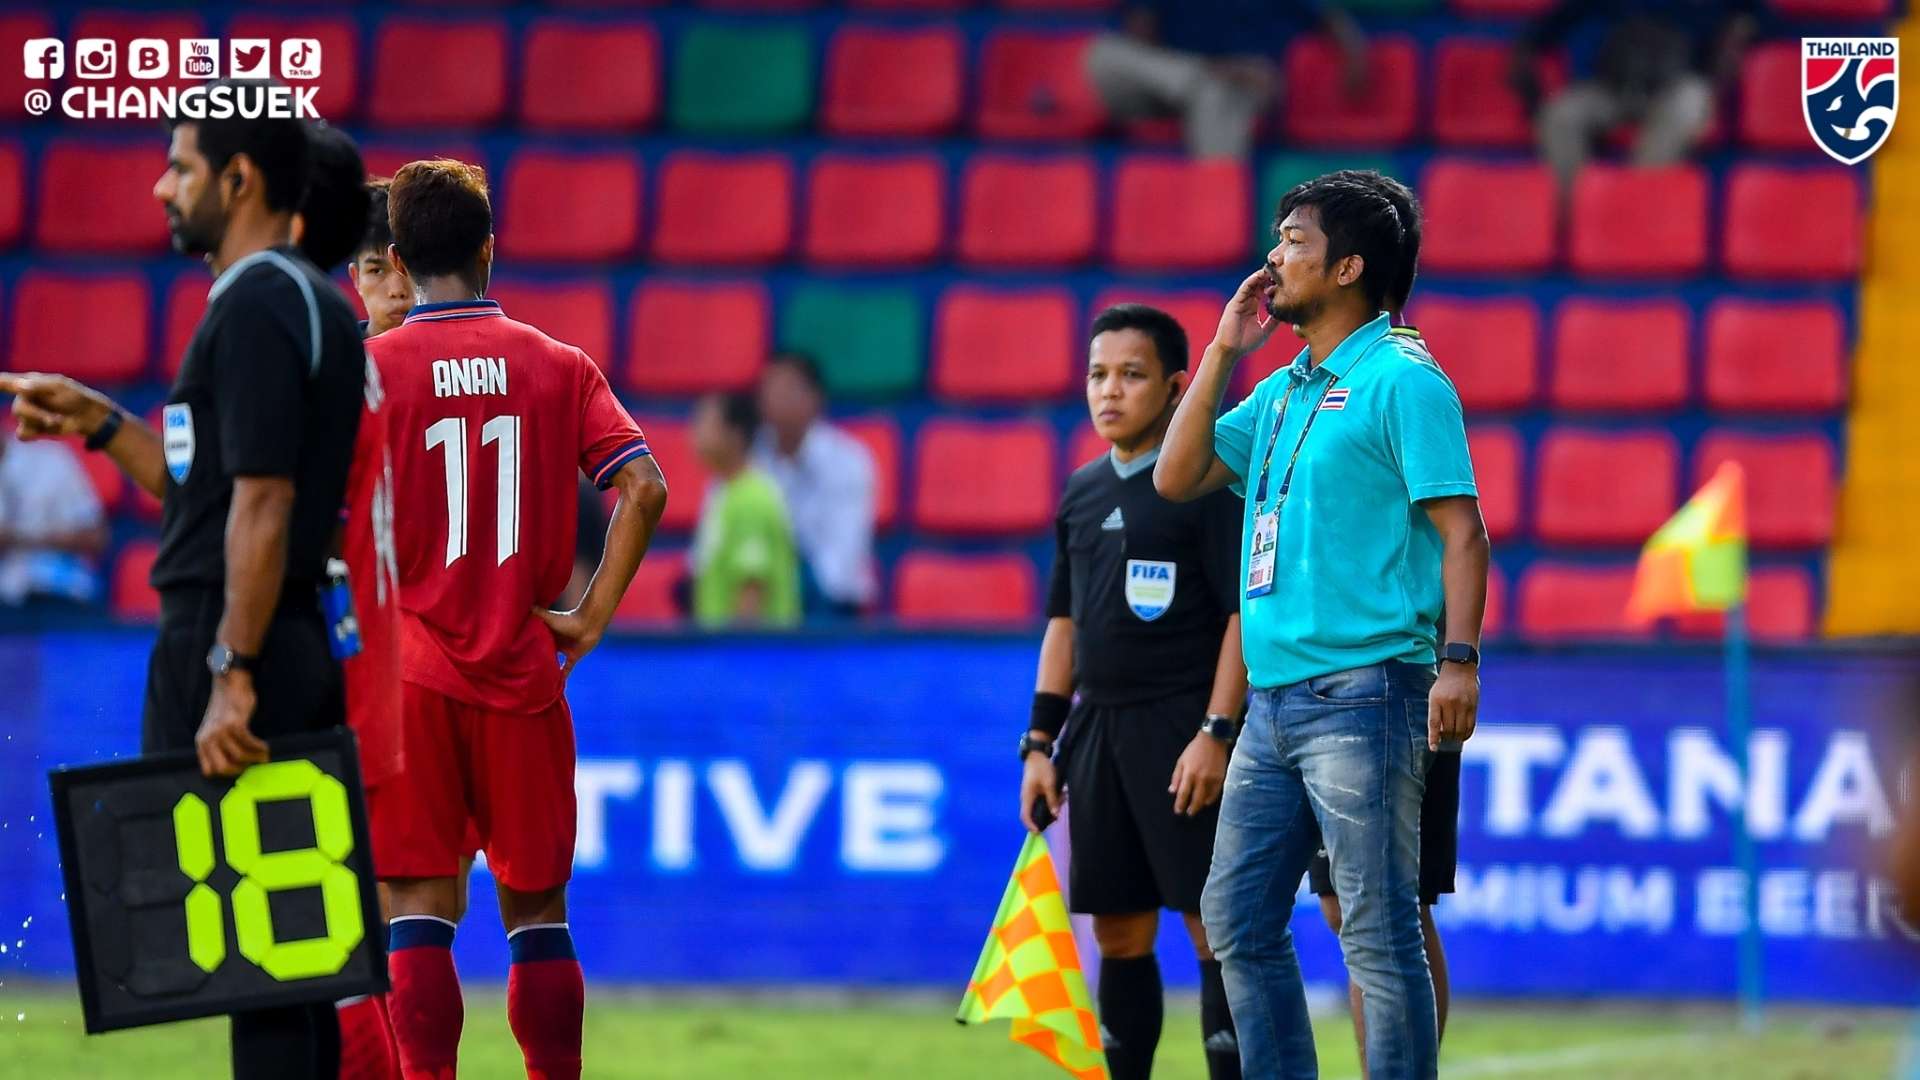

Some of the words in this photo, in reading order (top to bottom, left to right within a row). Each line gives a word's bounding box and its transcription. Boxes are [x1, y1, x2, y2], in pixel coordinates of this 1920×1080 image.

[432, 357, 507, 398] ANAN
[425, 415, 520, 569] 11
[1131, 564, 1170, 580] FIFA
[172, 758, 365, 982] 18
[574, 758, 946, 871] TIVE
